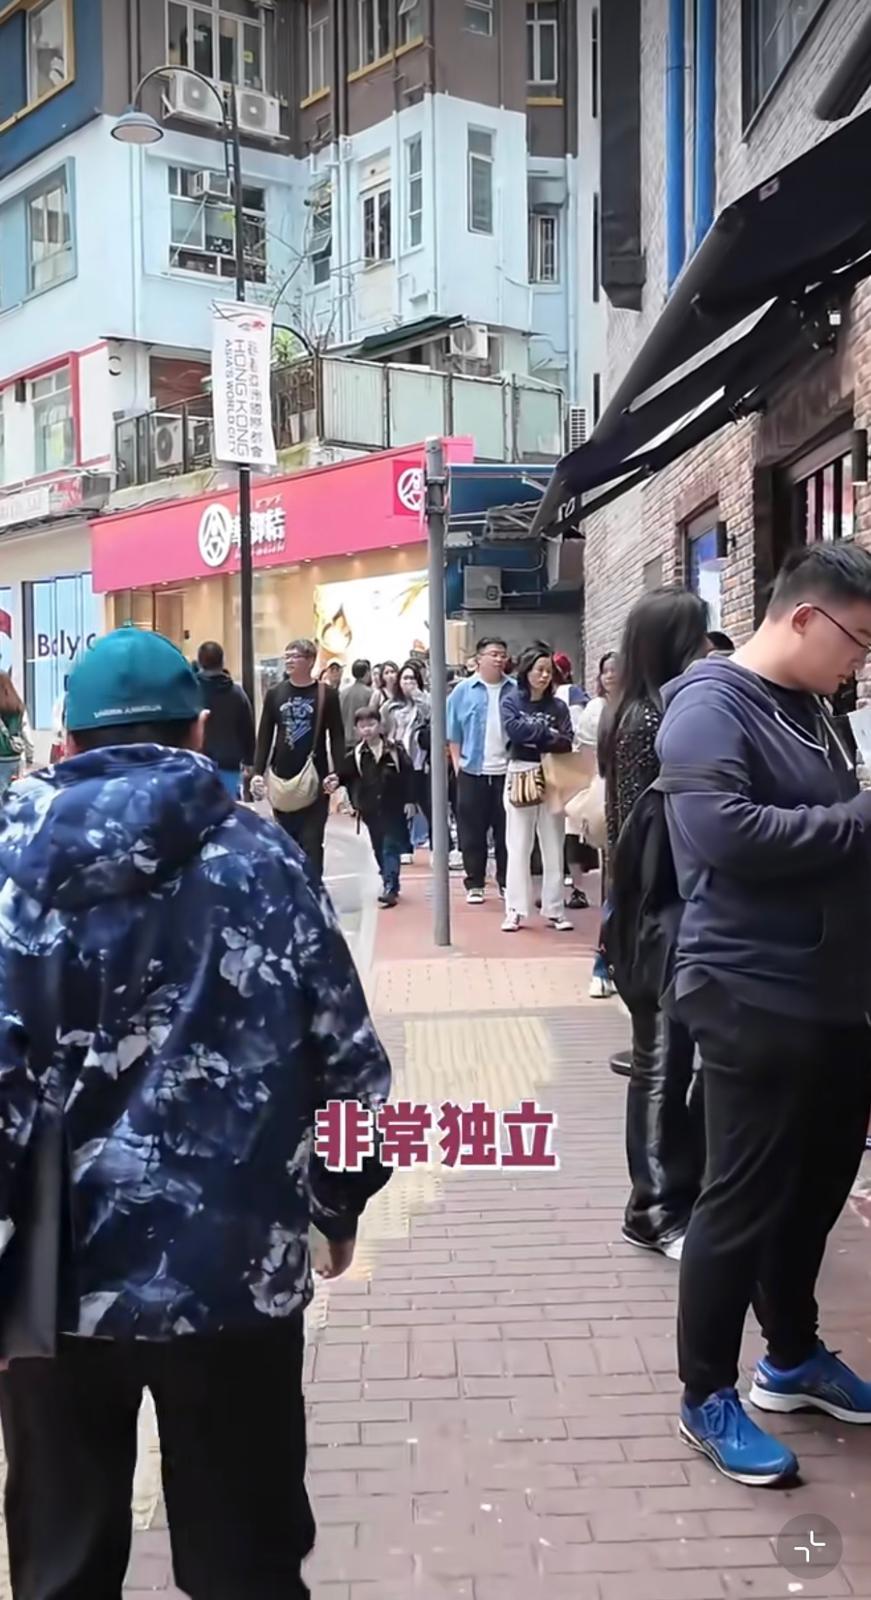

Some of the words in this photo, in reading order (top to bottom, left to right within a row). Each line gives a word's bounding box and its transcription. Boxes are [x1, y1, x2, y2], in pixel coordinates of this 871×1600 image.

[234, 339, 248, 397] HONG
[225, 381, 236, 424] WORLD
[227, 427, 237, 456] CITY
[236, 399, 249, 457] KONG
